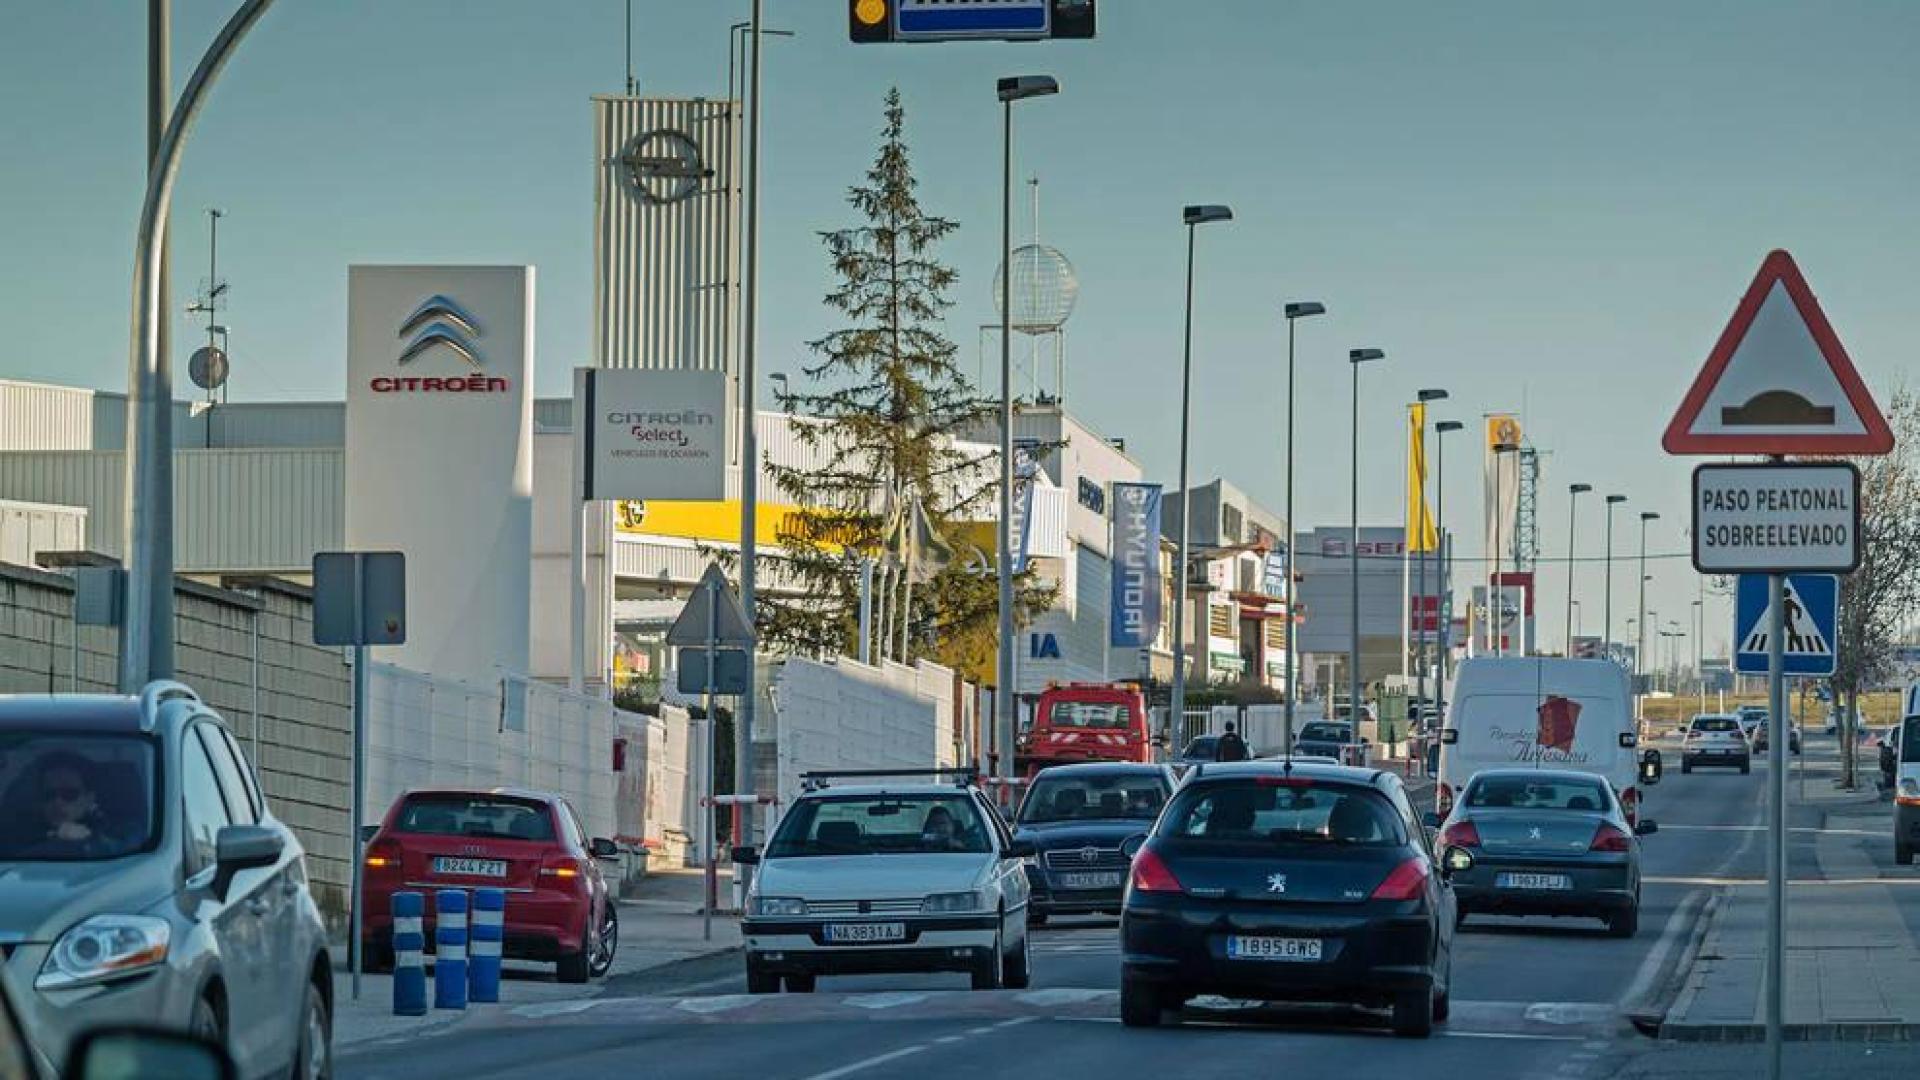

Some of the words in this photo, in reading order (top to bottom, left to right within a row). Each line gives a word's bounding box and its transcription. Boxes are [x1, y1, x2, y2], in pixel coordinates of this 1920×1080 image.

[1703, 488, 1750, 512] PASO
[1756, 488, 1849, 512] PEATONAL
[1705, 524, 1848, 547] SOBREELEVADO
[1124, 514, 1147, 633] HYUNDAI
[1241, 939, 1281, 956] 1895
